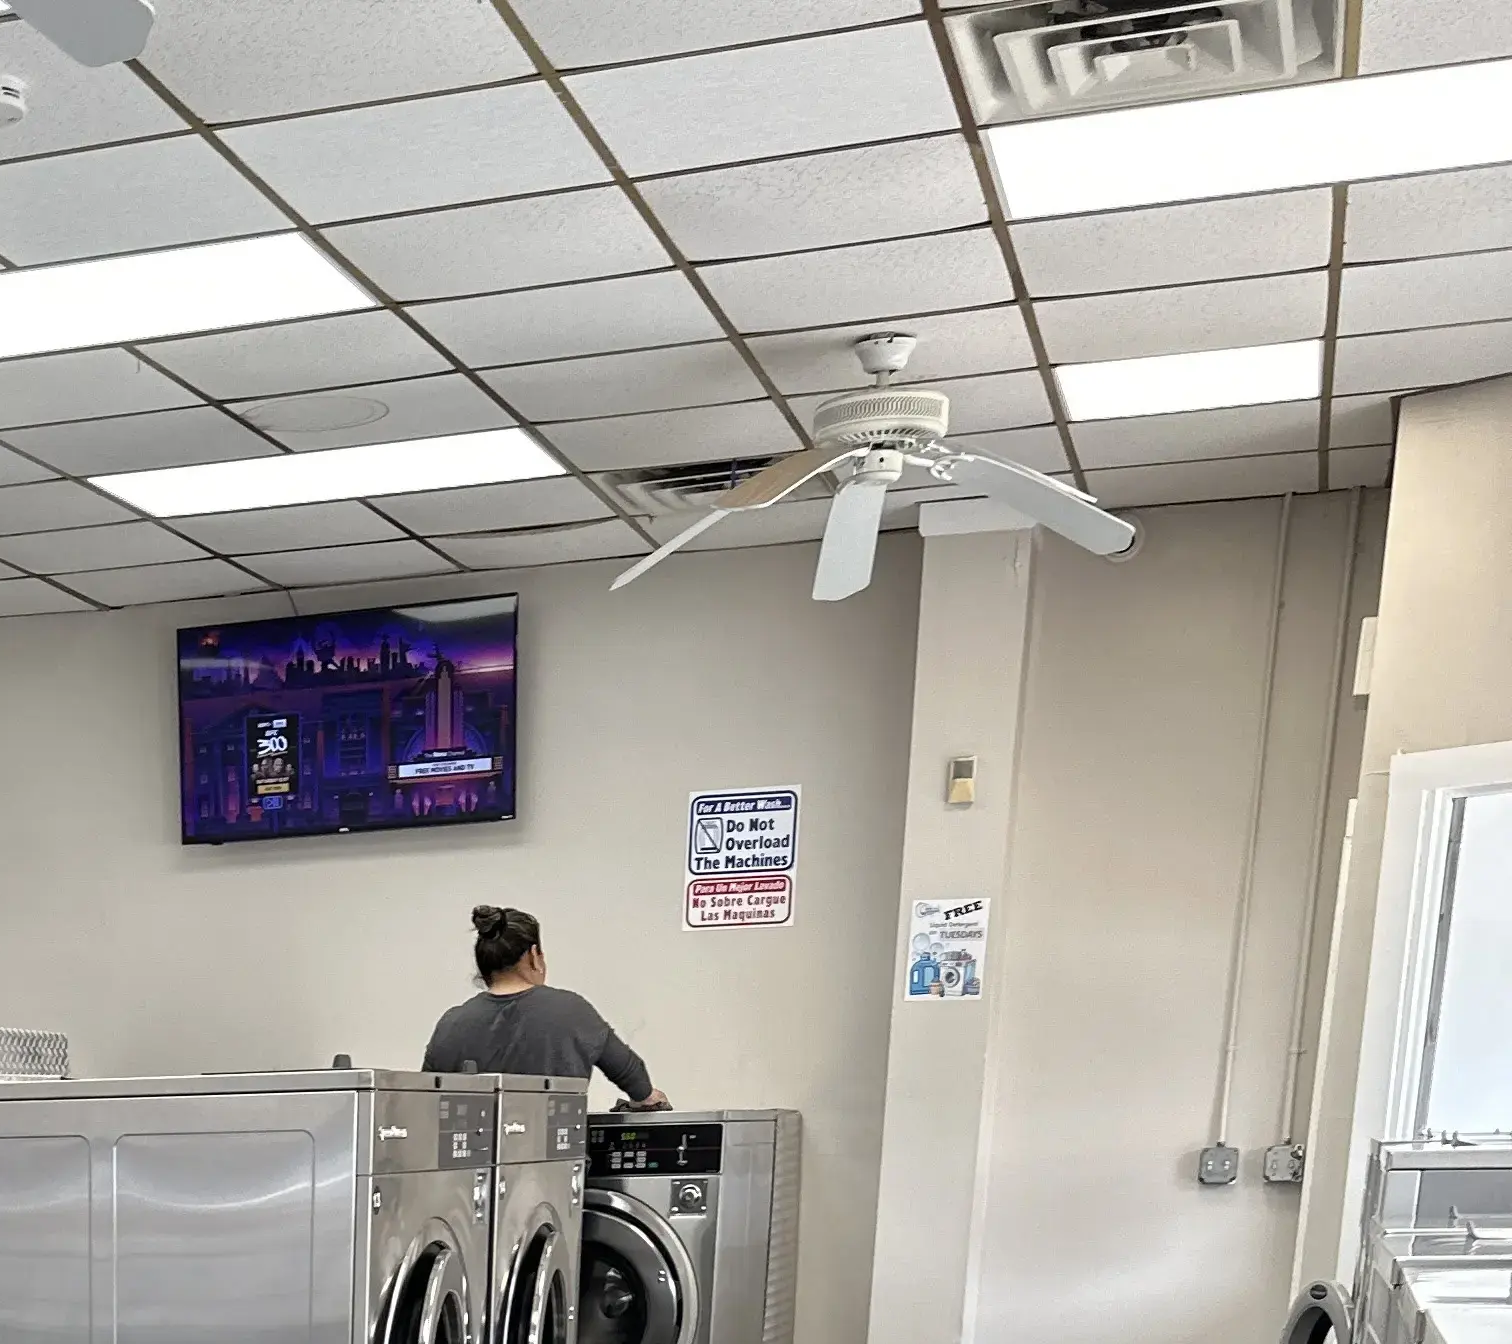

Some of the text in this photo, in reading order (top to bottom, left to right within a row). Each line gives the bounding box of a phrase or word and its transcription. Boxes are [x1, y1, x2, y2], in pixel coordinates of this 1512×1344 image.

[698, 804, 712, 813] For
[715, 803, 722, 812] A
[726, 818, 775, 832] Do Not
[726, 834, 790, 850] Overload
[695, 853, 788, 870] The Machines
[694, 884, 712, 893] Para
[692, 895, 786, 908] No Sobre Cargue
[701, 908, 775, 921] Las Maquinas
[944, 901, 984, 920] FREE
[940, 931, 983, 939] TUESDAYS
